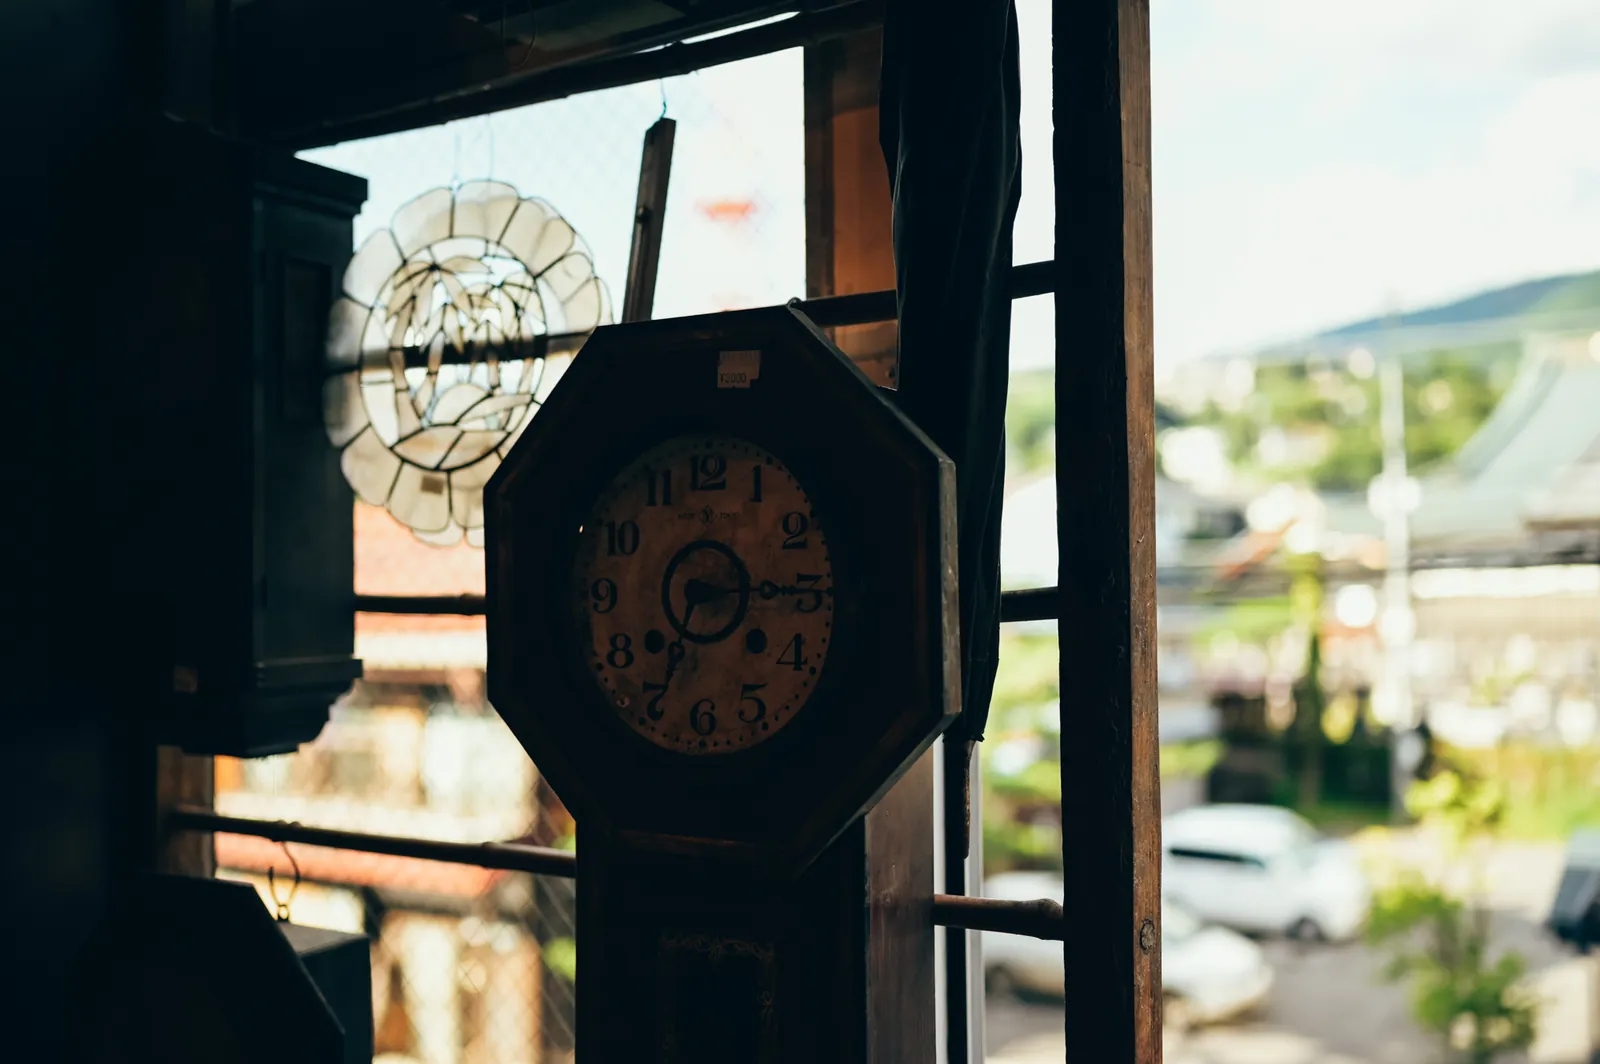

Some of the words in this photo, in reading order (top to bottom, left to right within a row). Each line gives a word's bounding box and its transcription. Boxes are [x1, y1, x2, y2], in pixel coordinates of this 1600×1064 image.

[646, 469, 673, 506] 11
[690, 455, 727, 491] 12
[751, 466, 763, 503] 1
[604, 520, 640, 556] 10
[781, 512, 809, 550] 2
[590, 578, 618, 614] 9
[796, 573, 823, 613] 3
[606, 633, 634, 669] 8
[776, 633, 808, 671] 4
[643, 682, 667, 720] 7
[689, 699, 716, 736] 6
[738, 683, 767, 723] 5
